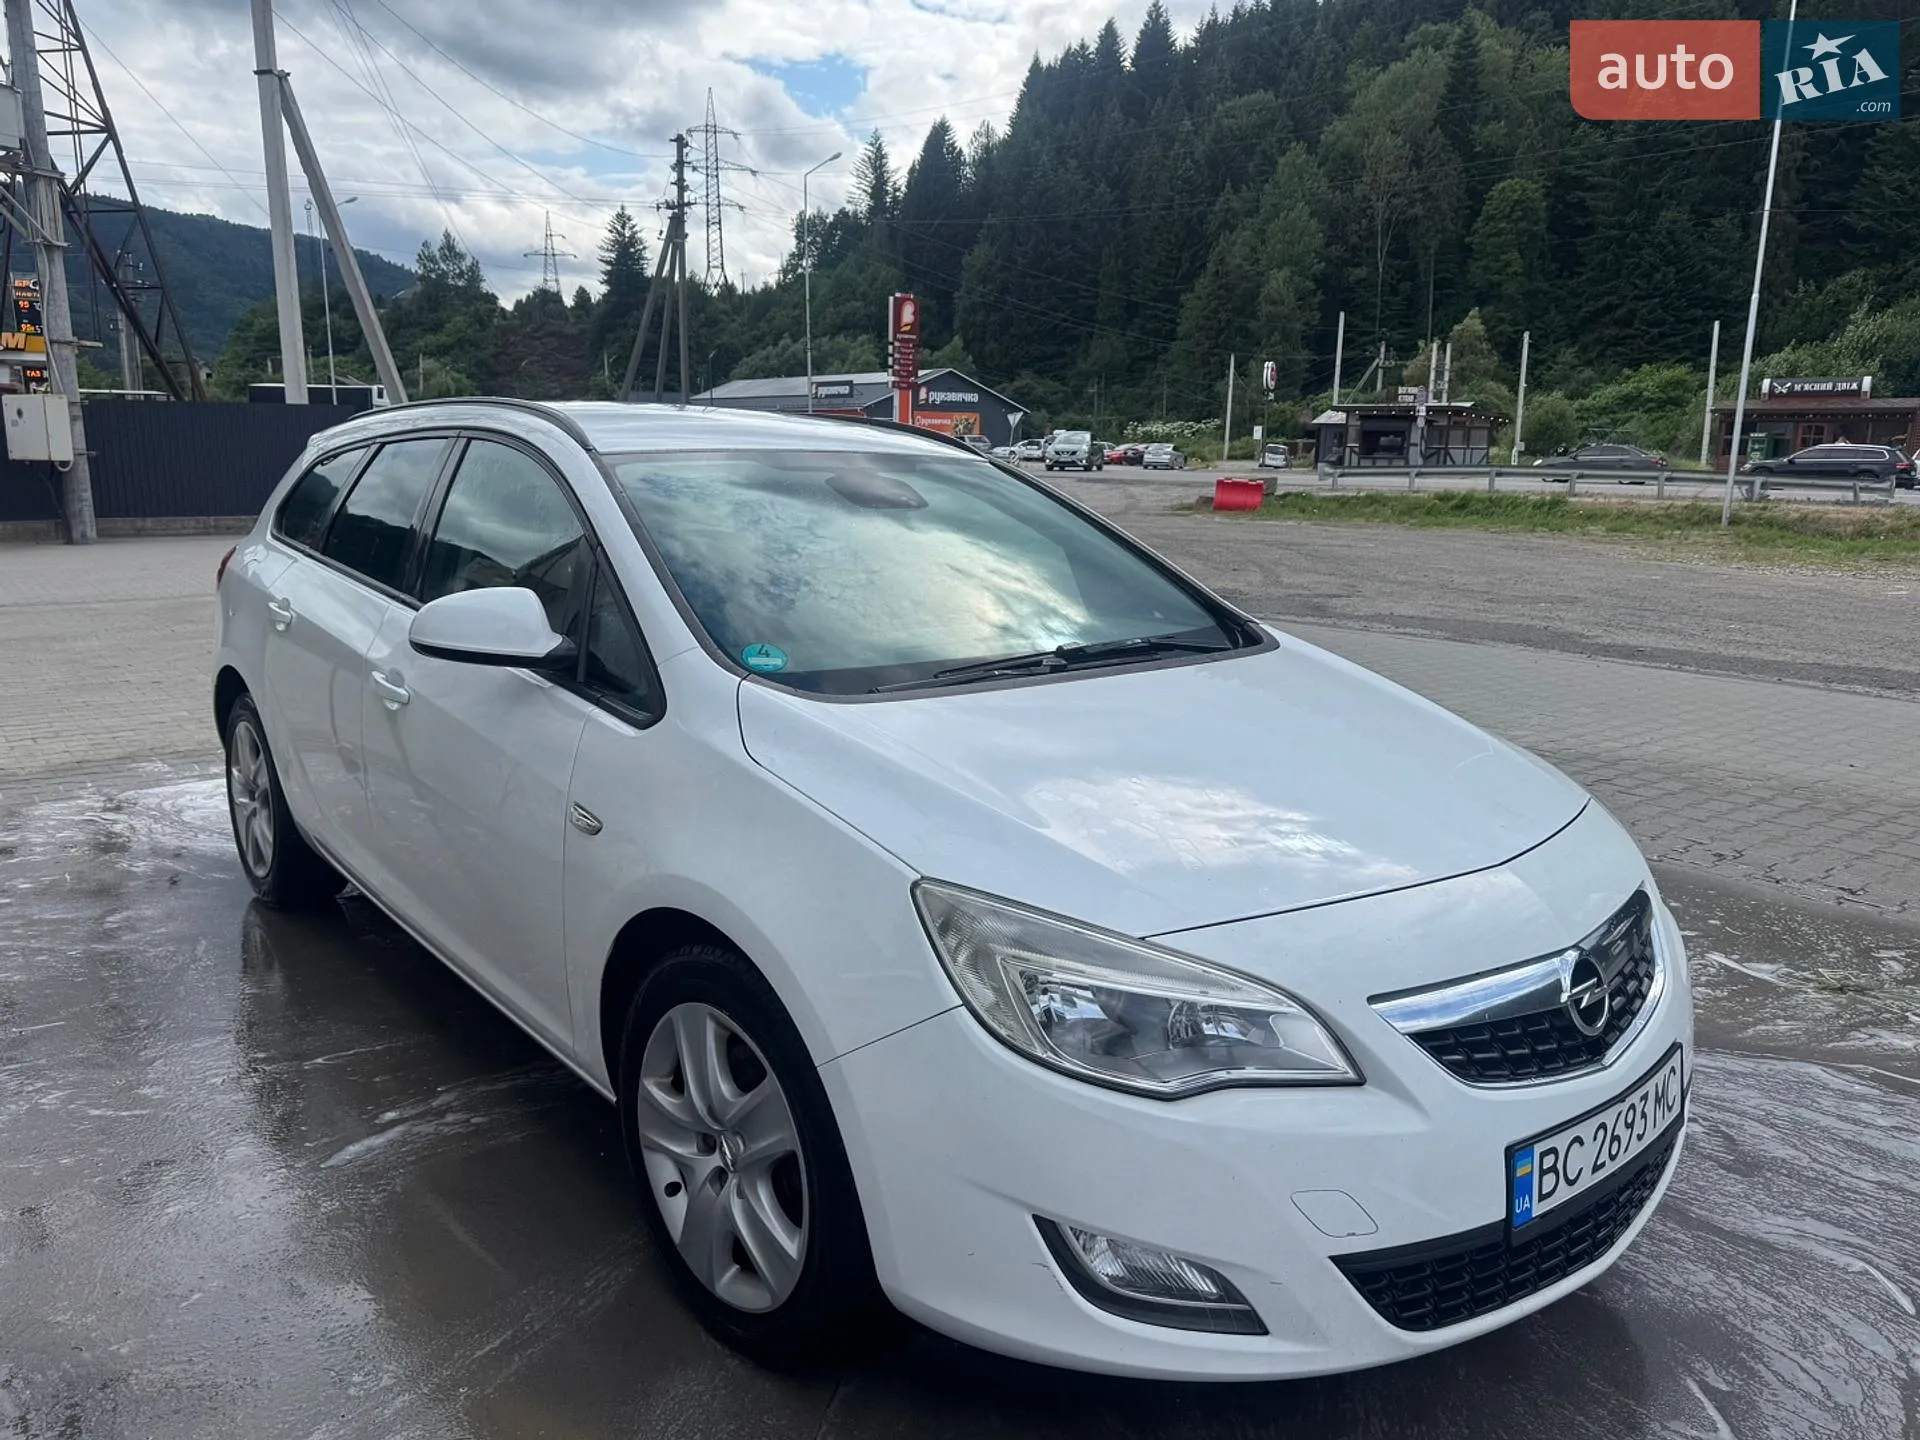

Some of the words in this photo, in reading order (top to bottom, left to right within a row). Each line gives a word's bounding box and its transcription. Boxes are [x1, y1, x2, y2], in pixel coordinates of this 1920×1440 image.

[928, 391, 979, 404] рукавичка
[1538, 1134, 1585, 1204] BC
[1591, 1090, 1649, 1176] 2693
[1653, 1065, 1676, 1129] MC
[1515, 1194, 1531, 1213] UA
